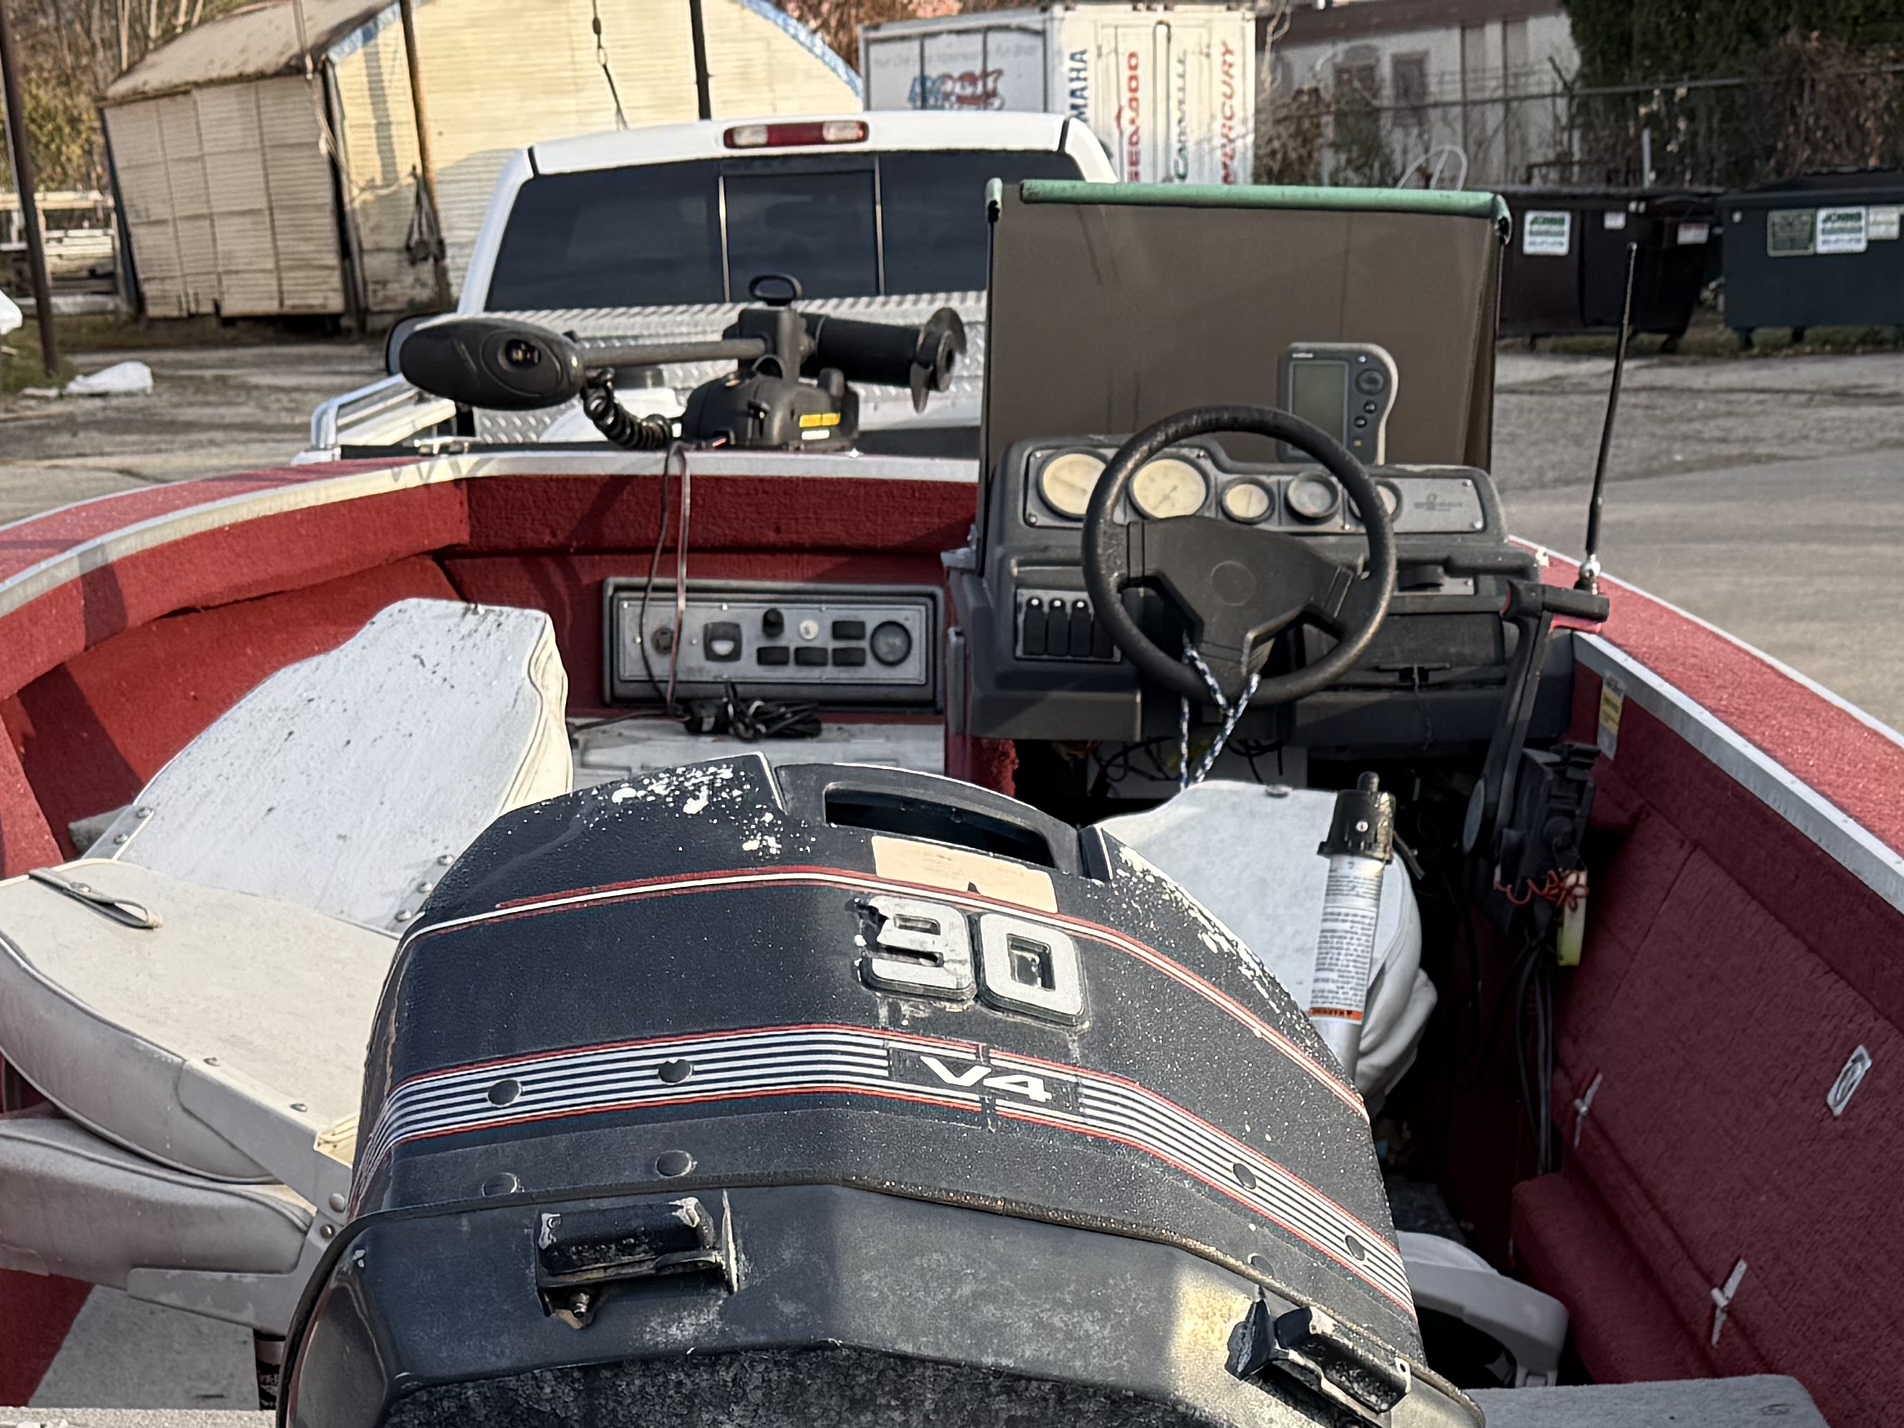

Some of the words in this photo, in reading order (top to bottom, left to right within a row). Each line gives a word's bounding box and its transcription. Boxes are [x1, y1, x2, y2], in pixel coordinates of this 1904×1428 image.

[1069, 48, 1089, 122] MAHA
[860, 895, 1088, 1026] 90
[920, 1055, 1053, 1102] V4
